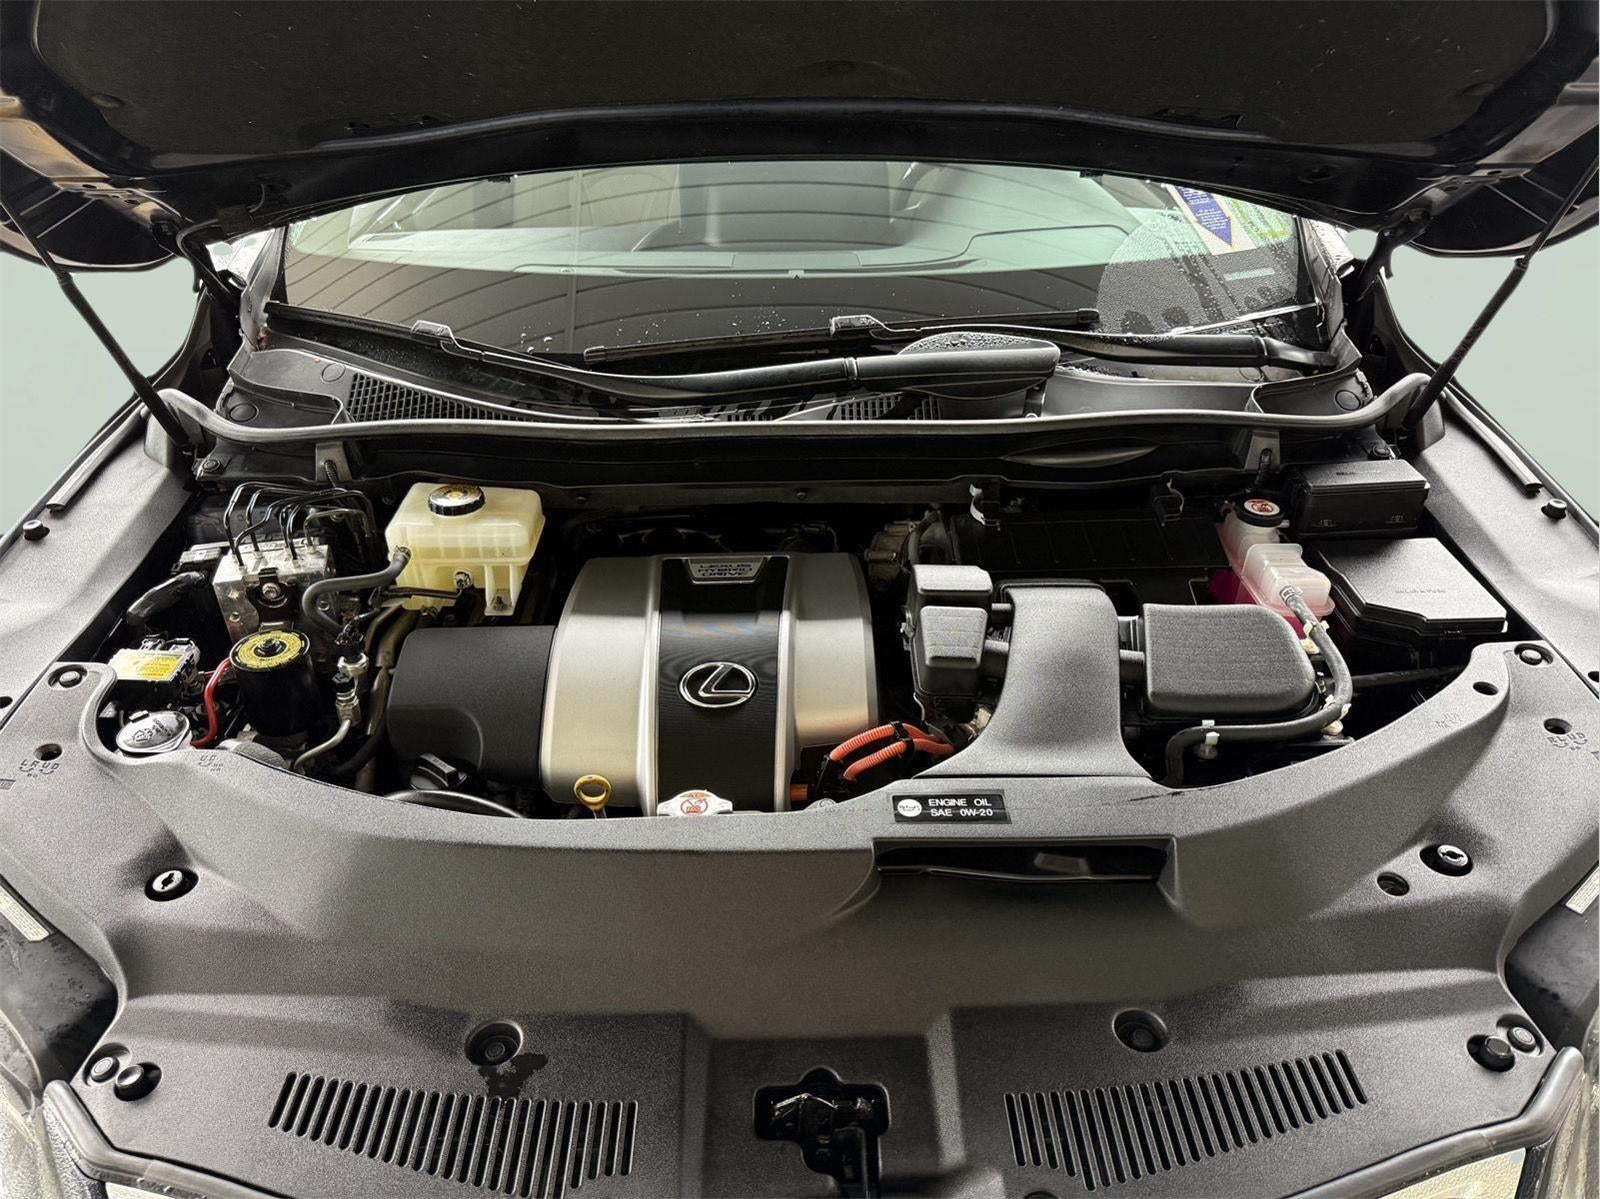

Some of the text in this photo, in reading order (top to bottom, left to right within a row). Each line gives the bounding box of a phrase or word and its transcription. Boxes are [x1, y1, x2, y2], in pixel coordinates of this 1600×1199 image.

[928, 798, 992, 807] ENGINE OIL
[930, 808, 994, 817] SAE 0W-20
